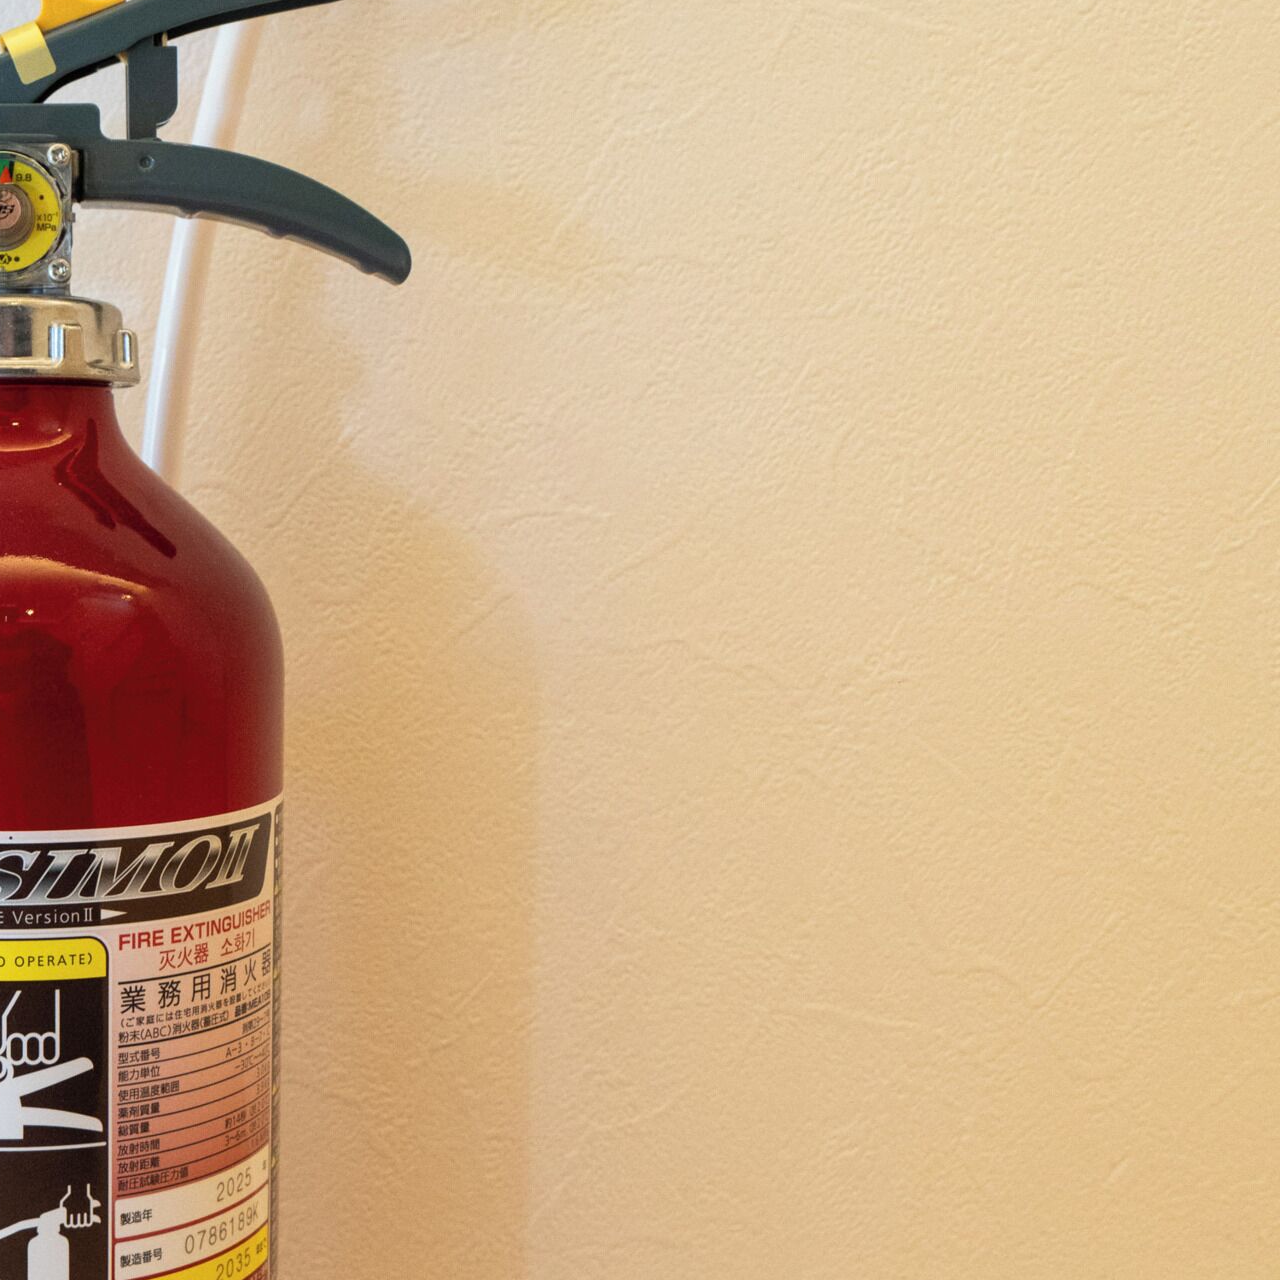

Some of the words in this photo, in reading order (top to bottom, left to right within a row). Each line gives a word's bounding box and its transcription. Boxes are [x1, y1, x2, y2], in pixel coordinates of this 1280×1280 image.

[16, 173, 32, 182] 9.8
[36, 222, 57, 232] MPa
[118, 929, 164, 951] FIRE
[171, 900, 271, 944] EXTINGUISHER
[220, 929, 255, 957] 소화기
[15, 953, 93, 967] OPERATE)
[159, 943, 208, 971] 灭火器
[120, 949, 271, 1014] 業務用消火器
[118, 1047, 161, 1065] 型式番号
[216, 1167, 252, 1203] 2025
[120, 1208, 153, 1226] 製造年
[184, 1201, 259, 1254] 0786189K
[120, 1247, 163, 1268] 製造番号
